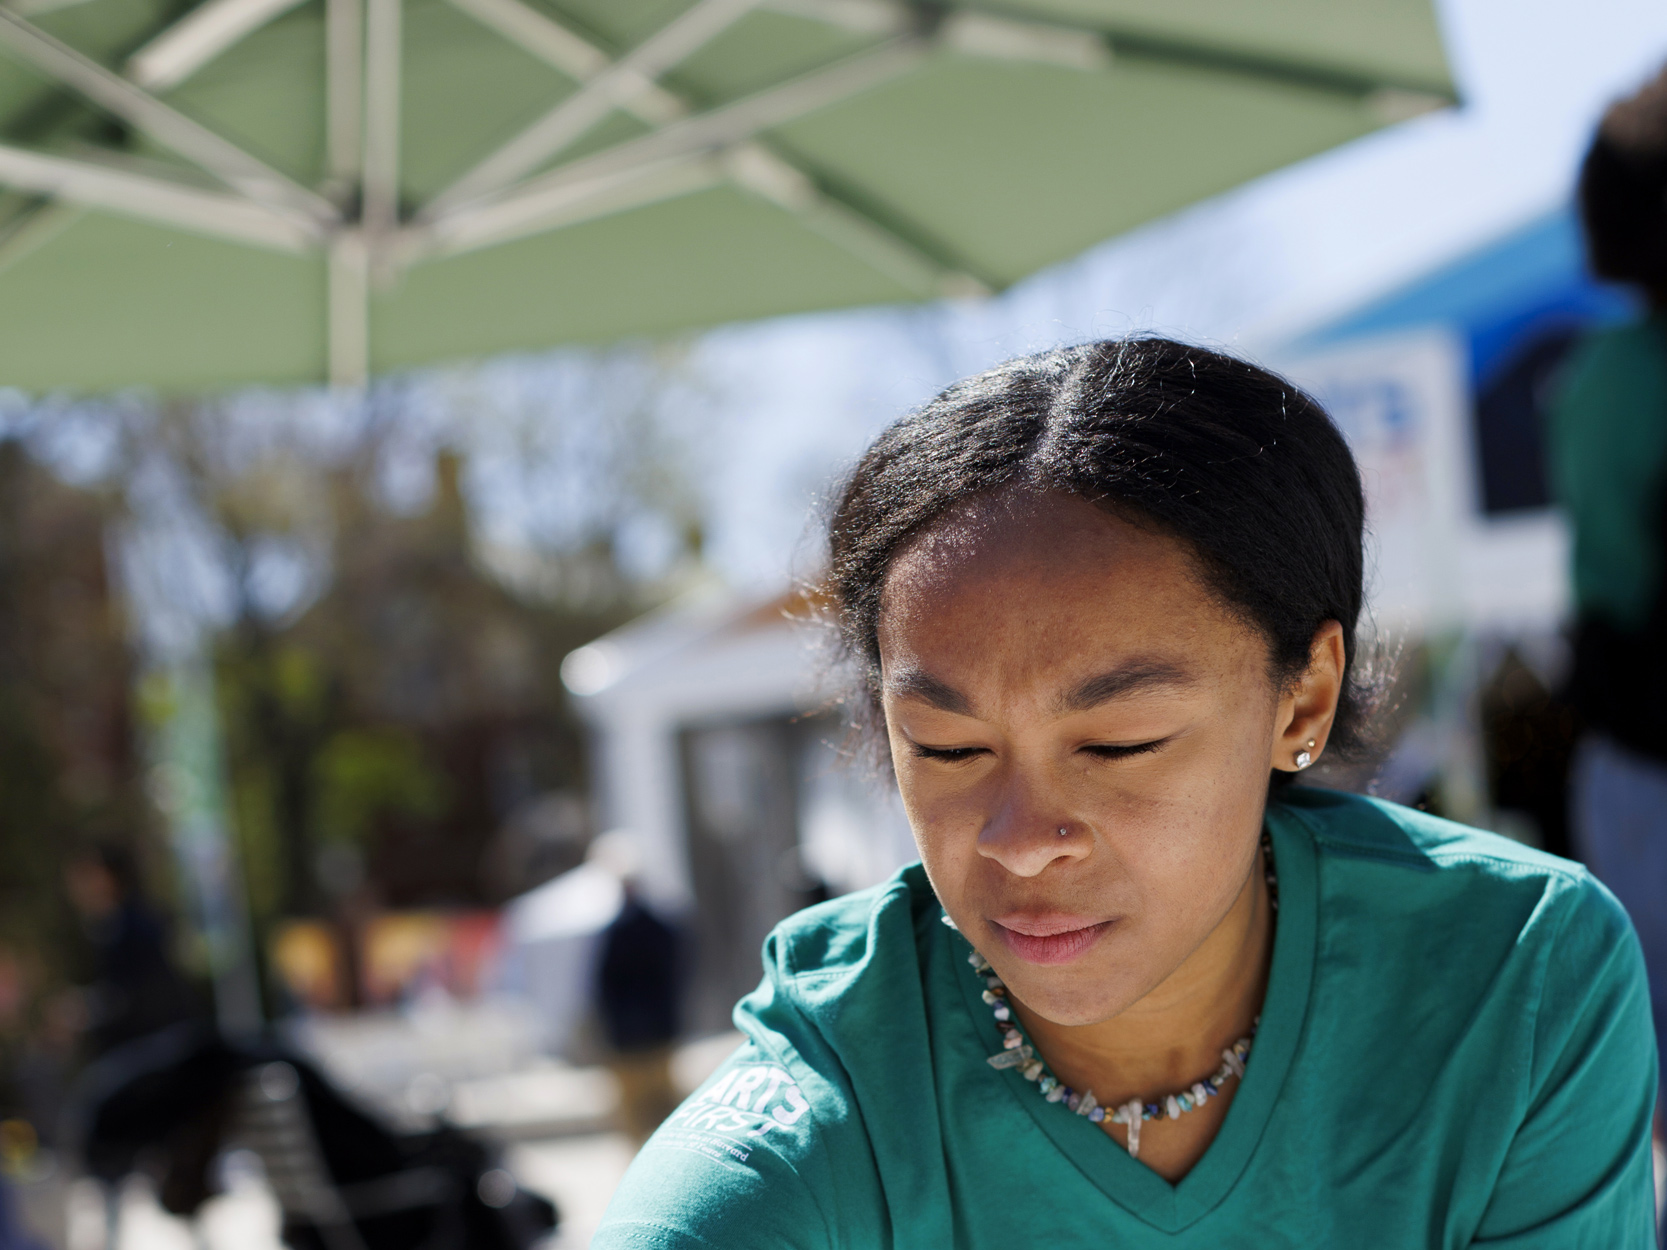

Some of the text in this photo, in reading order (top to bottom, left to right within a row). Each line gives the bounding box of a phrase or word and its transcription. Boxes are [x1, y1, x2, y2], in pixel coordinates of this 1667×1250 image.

[697, 1066, 810, 1125] ARTS
[666, 1101, 797, 1137] FIRST
[710, 1138, 749, 1162] Harvard
